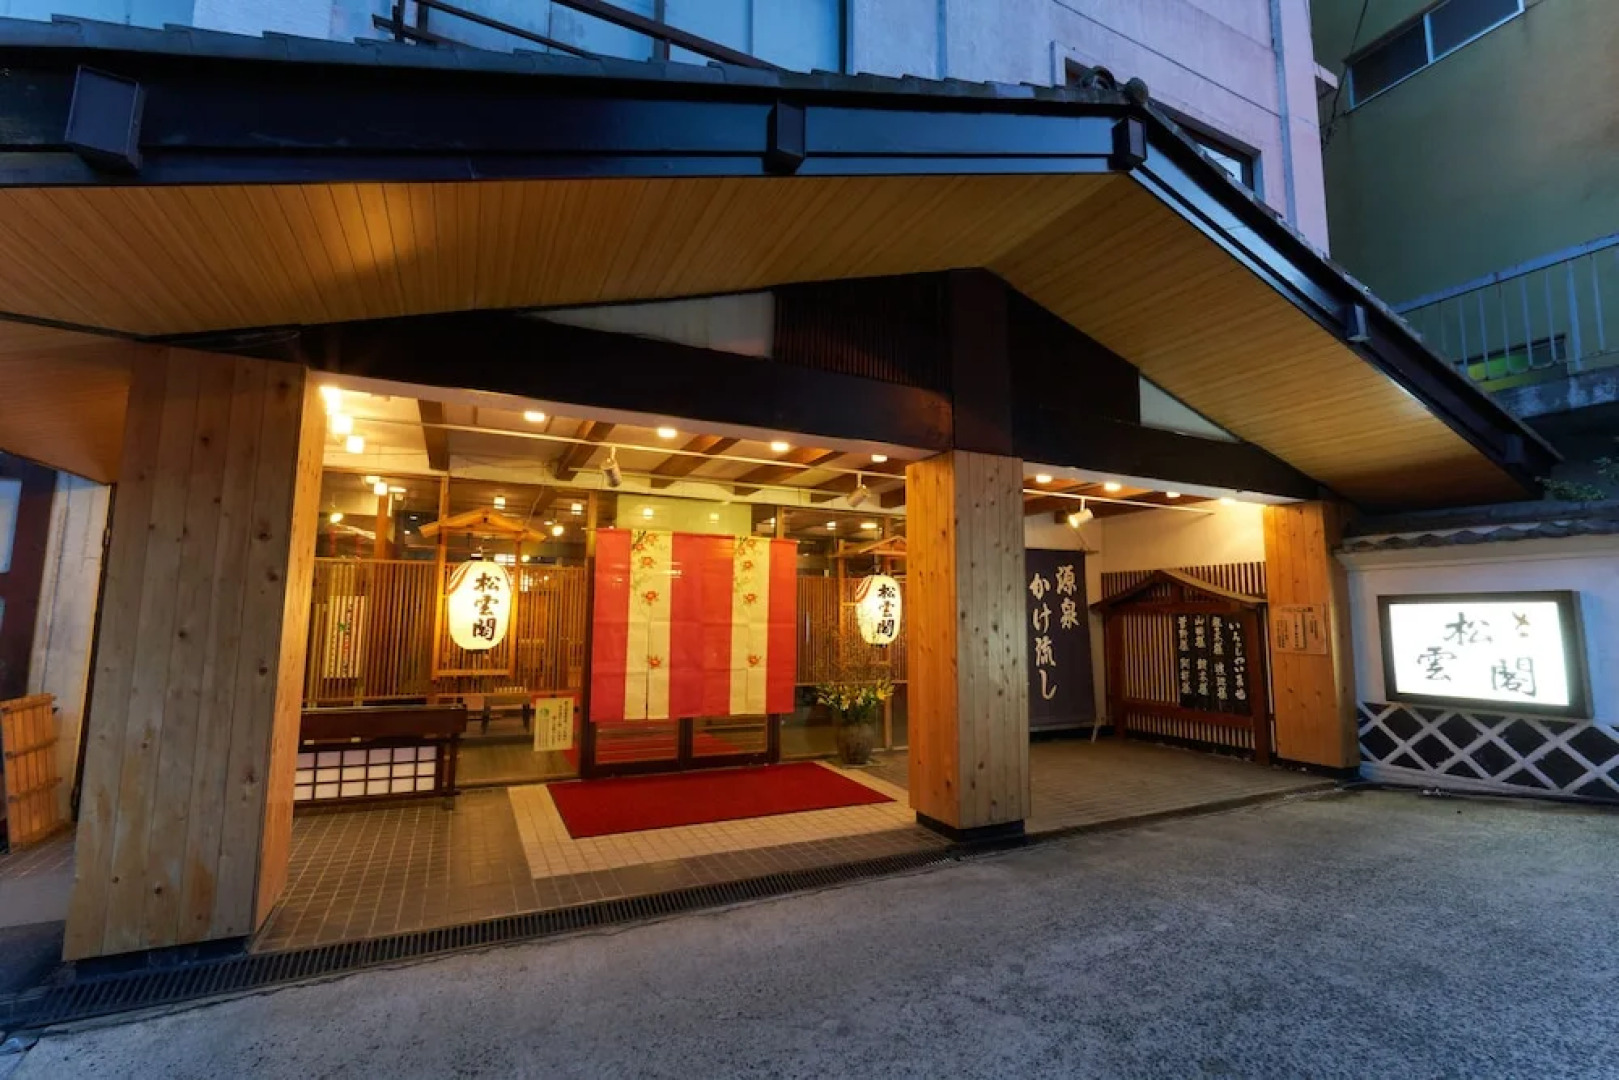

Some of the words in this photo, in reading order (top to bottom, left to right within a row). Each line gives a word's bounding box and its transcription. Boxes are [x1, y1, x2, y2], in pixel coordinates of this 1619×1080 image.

[1029, 572, 1058, 700] かけ流し
[1055, 564, 1080, 630] 源泉
